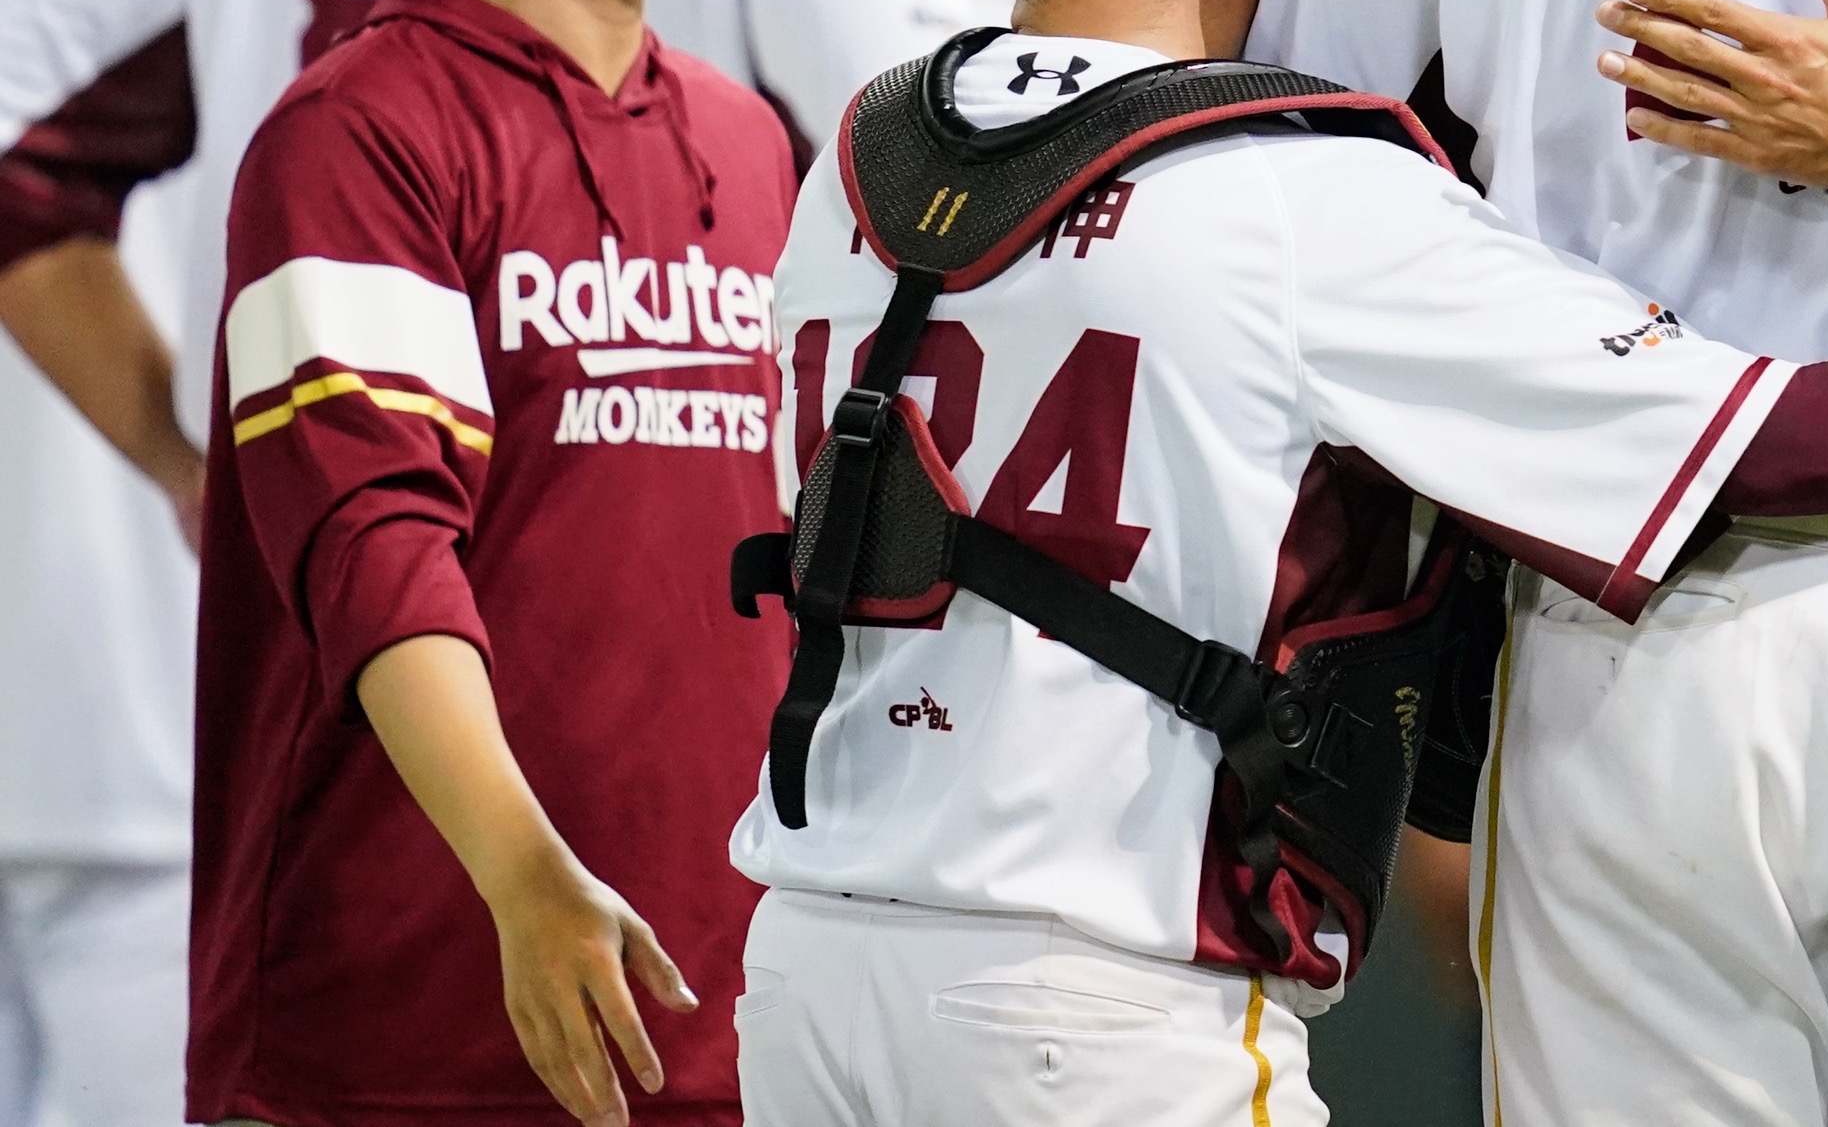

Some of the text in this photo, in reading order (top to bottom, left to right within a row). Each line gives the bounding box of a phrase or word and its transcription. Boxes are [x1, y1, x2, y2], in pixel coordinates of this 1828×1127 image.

[498, 234, 781, 355] Rakuten
[554, 385, 768, 453] MONKEYS
[888, 694, 953, 732] CPBL
